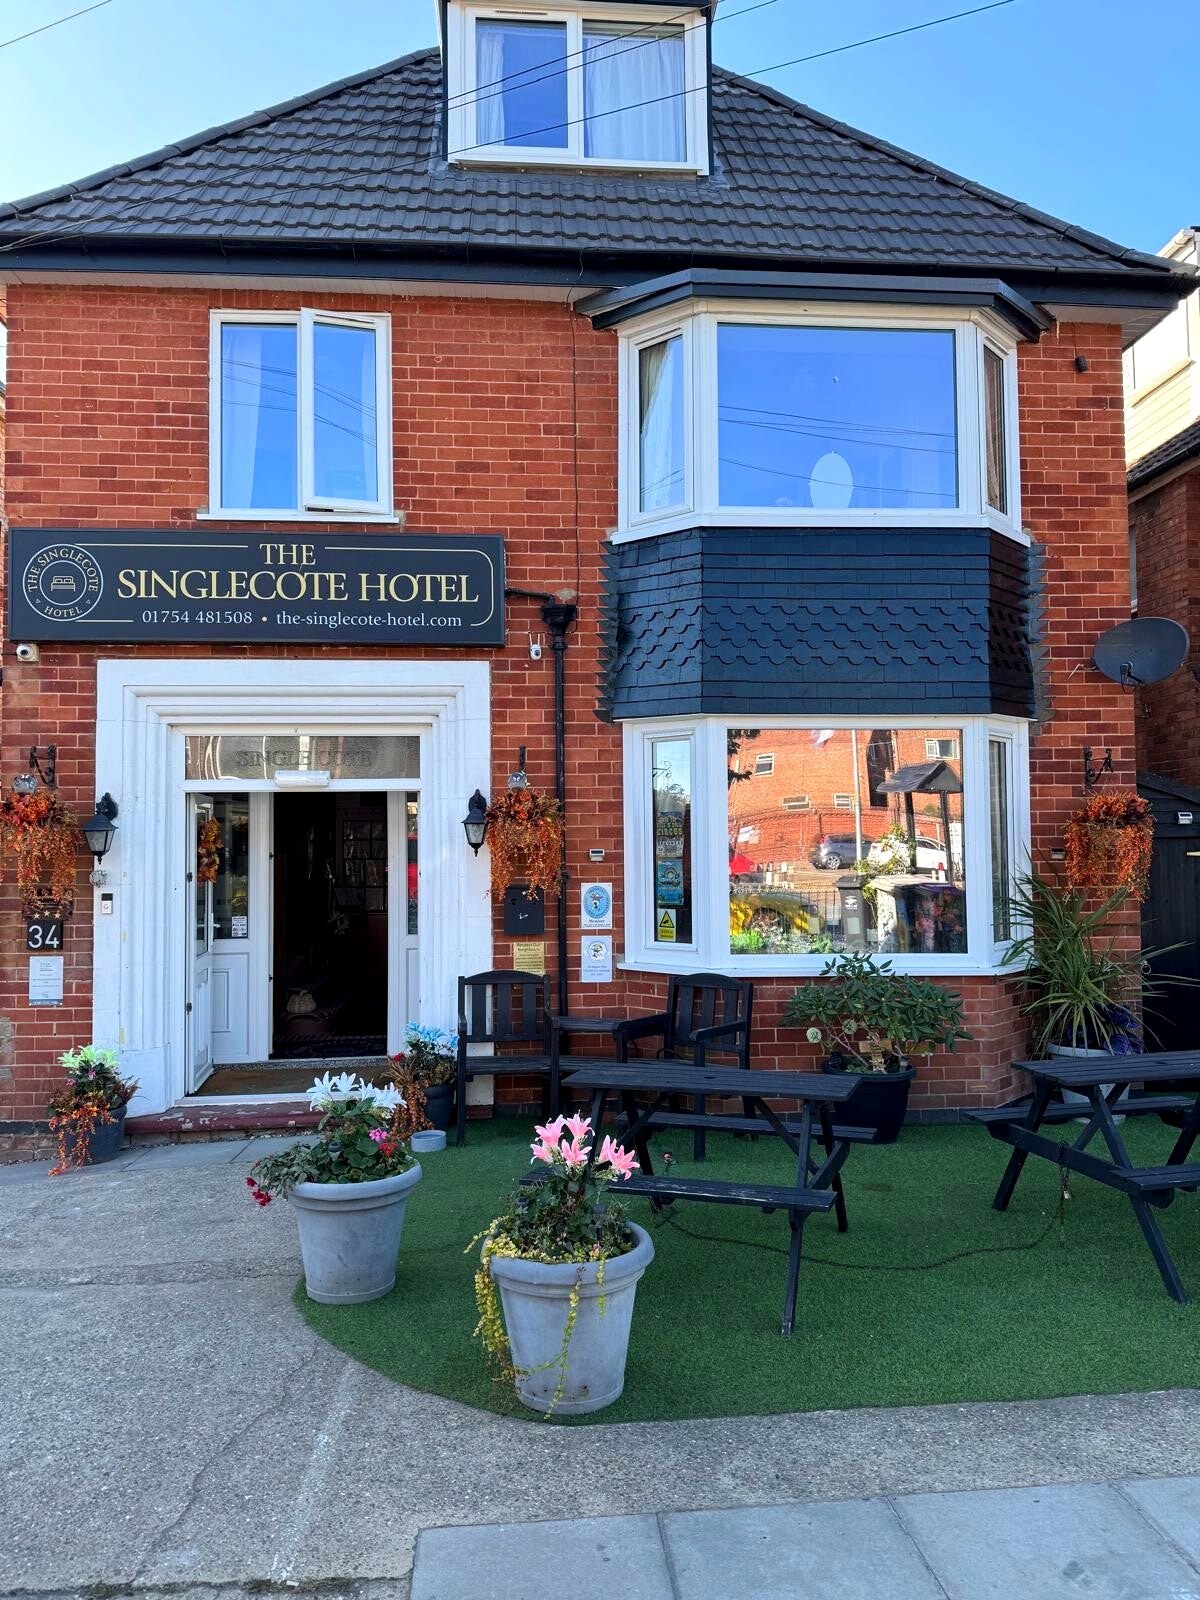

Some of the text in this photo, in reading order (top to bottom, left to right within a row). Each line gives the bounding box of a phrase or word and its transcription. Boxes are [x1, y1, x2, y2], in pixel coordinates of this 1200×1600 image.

[260, 543, 316, 565] THE
[27, 548, 99, 593] THE SINGLECOTE
[117, 569, 480, 603] SINGLECOTE HOTEL
[44, 605, 83, 618] HOTEL
[142, 610, 463, 629] 01754 481508 the-singlecote-hotel.com
[28, 924, 60, 949] 34
